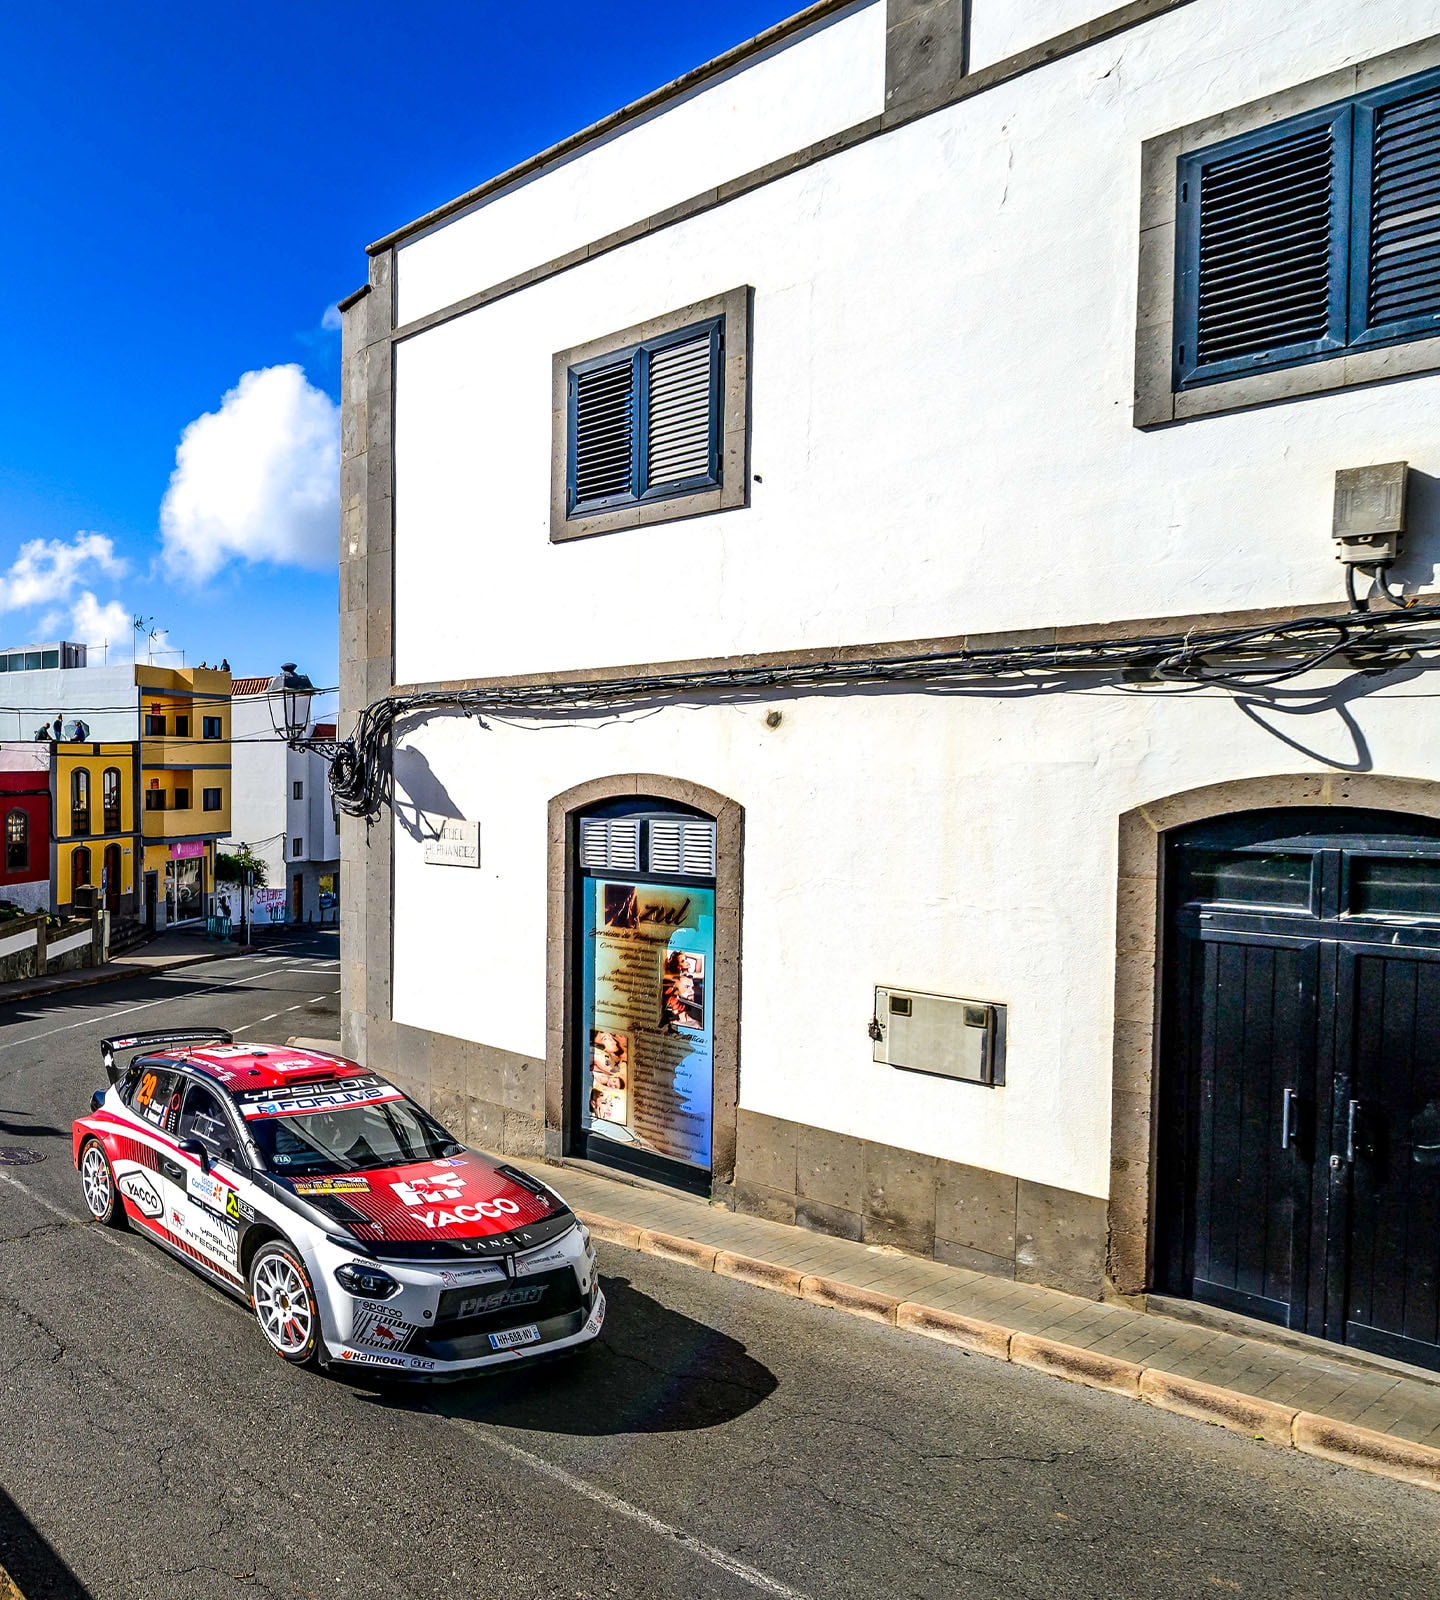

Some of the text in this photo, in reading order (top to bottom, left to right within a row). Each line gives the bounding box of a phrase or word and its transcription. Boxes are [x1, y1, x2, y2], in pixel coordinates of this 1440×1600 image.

[137, 1073, 158, 1106] 29
[244, 1077, 379, 1102] YPSILON
[279, 1088, 384, 1111] FORUM8
[275, 1155, 291, 1163] FIA
[126, 1180, 158, 1210] YACCO
[410, 1198, 520, 1229] YACCO
[462, 1233, 532, 1250] LANCIA
[362, 1301, 403, 1318] sparco
